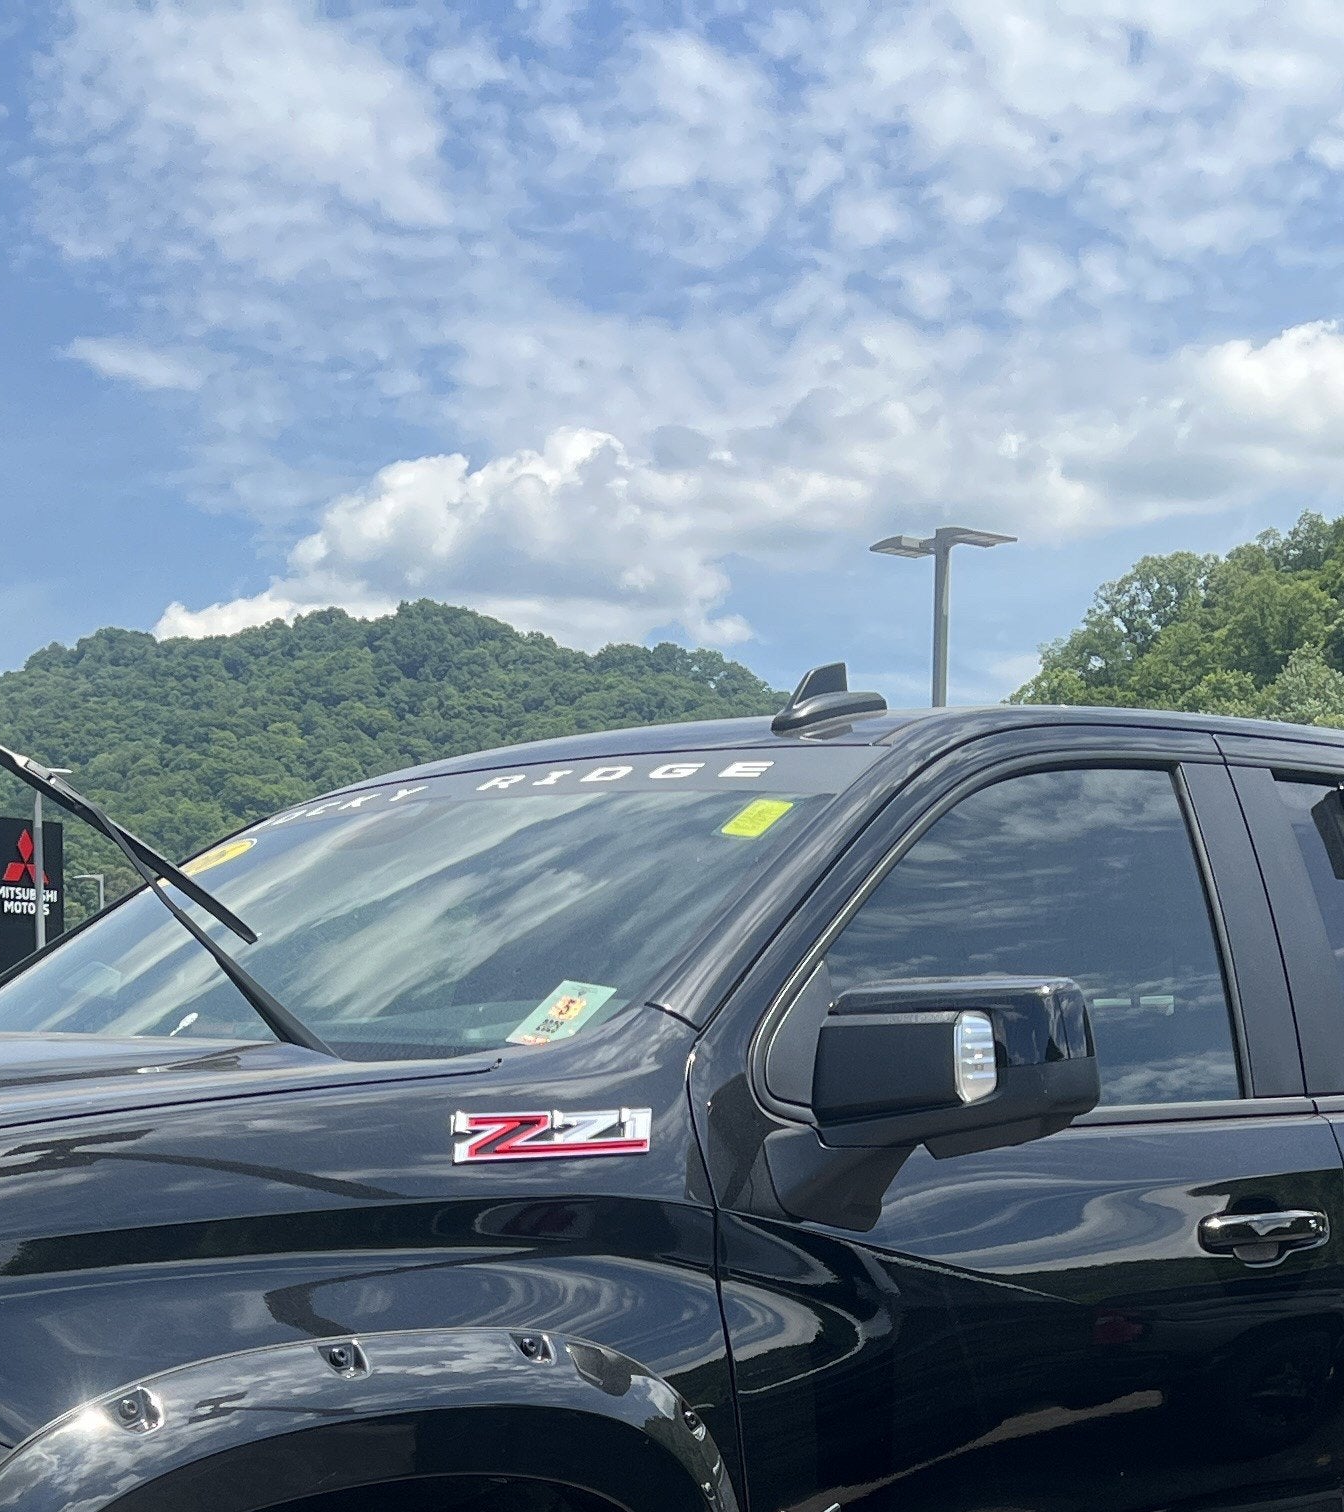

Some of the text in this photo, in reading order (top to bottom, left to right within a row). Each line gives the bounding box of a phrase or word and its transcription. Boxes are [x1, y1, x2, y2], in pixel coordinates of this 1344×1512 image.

[476, 760, 775, 791] RIDGE
[3, 900, 49, 916] MOTOS
[451, 1107, 652, 1164] Z71
